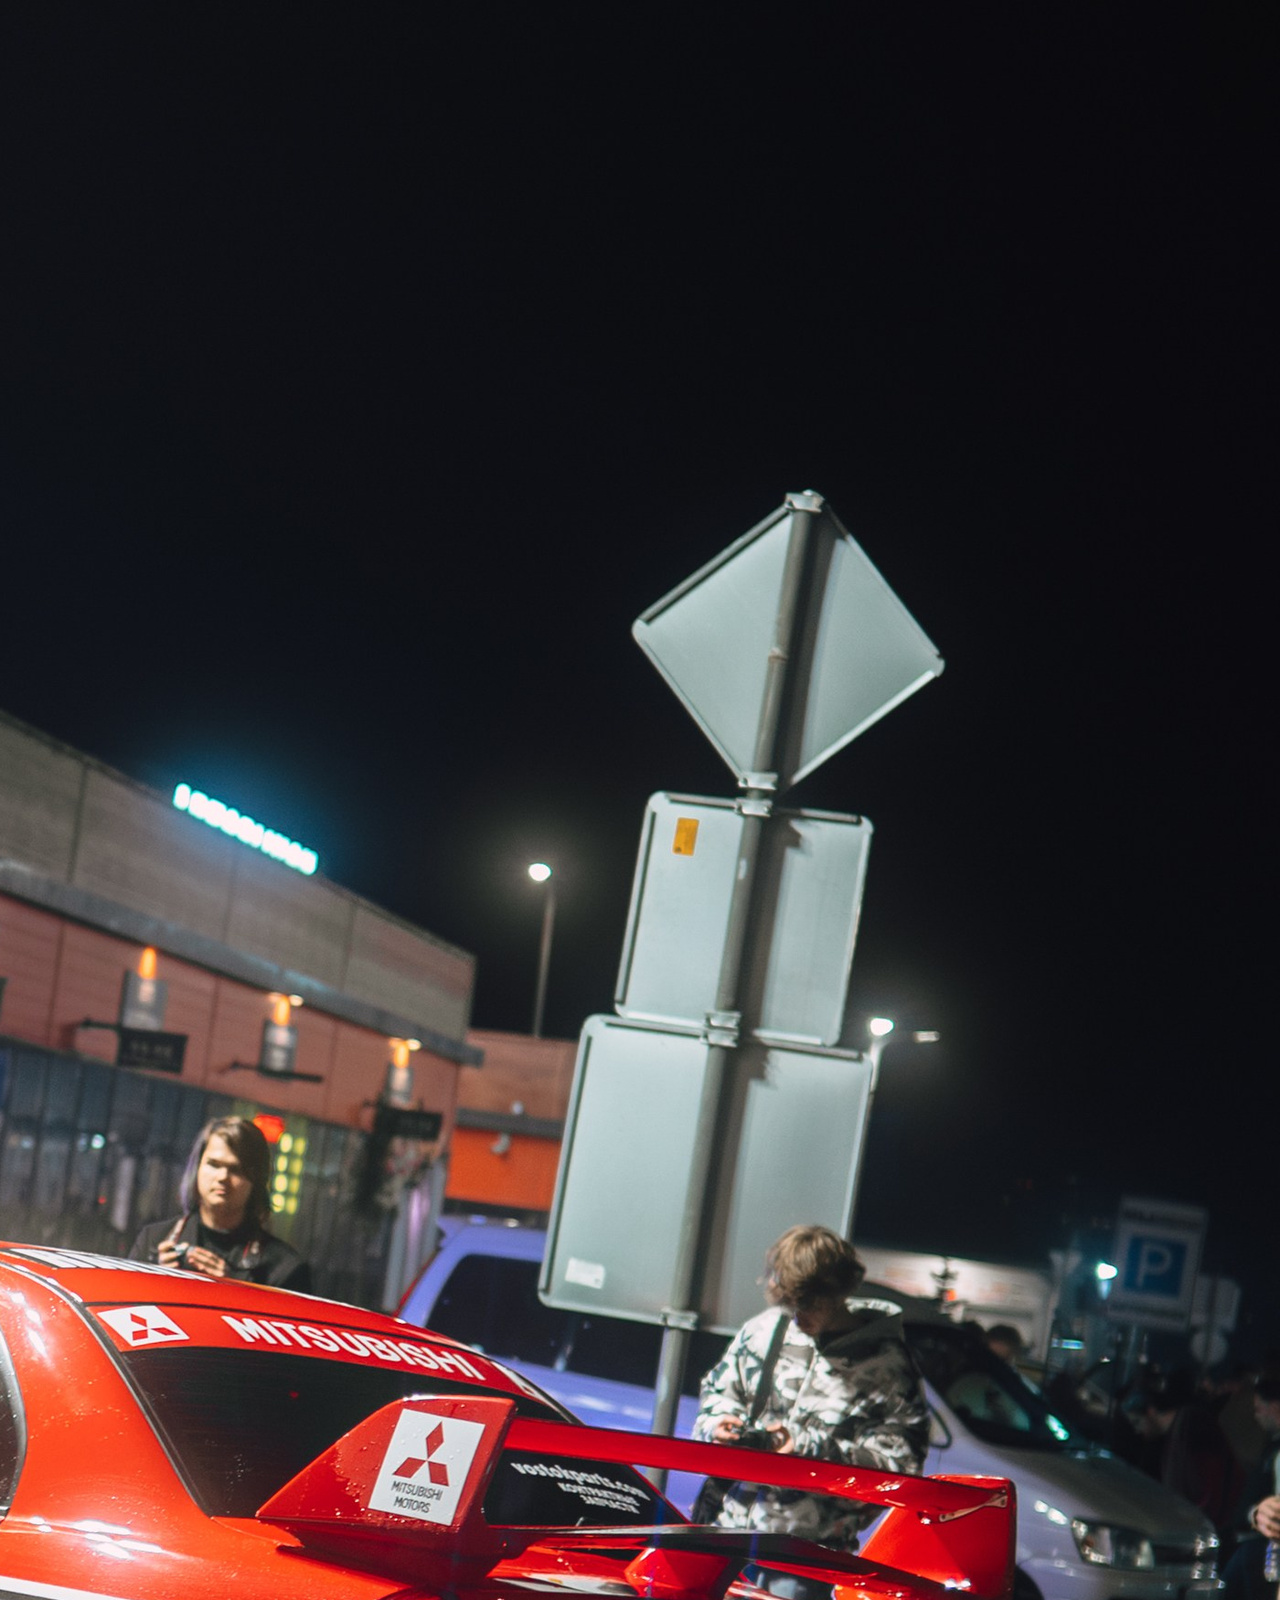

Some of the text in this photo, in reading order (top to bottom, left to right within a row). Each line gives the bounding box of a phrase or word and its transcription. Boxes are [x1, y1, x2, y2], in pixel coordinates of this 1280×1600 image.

[1136, 1244, 1173, 1287] P
[221, 1315, 486, 1381] MITSUBISHI
[391, 1480, 443, 1501] MITSUBISHI
[511, 1462, 651, 1501] vostokparts.com
[393, 1496, 431, 1514] MOTORS
